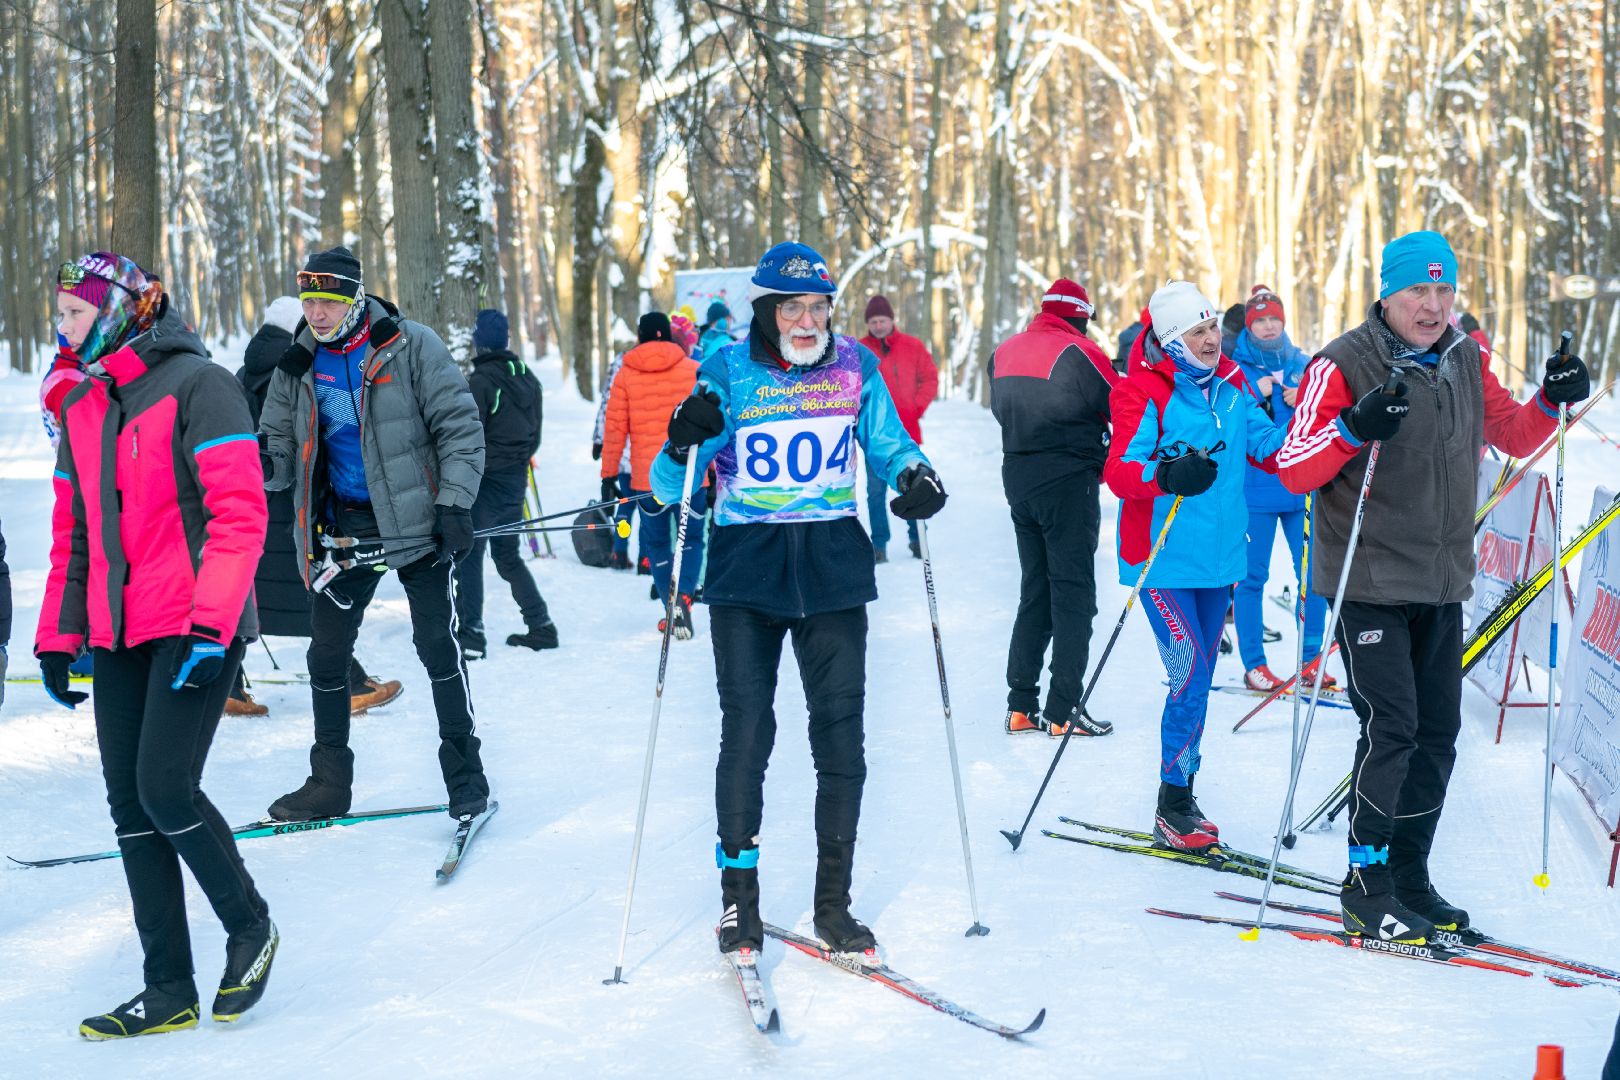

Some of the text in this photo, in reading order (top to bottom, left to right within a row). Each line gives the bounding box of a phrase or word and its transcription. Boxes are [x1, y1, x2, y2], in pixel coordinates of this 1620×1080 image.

[756, 379, 843, 402] Почувствуй
[738, 398, 857, 421] адость движени
[745, 424, 850, 484] 804
[1485, 585, 1539, 642] FISCHER
[1363, 938, 1434, 958] ROSSIGNOL
